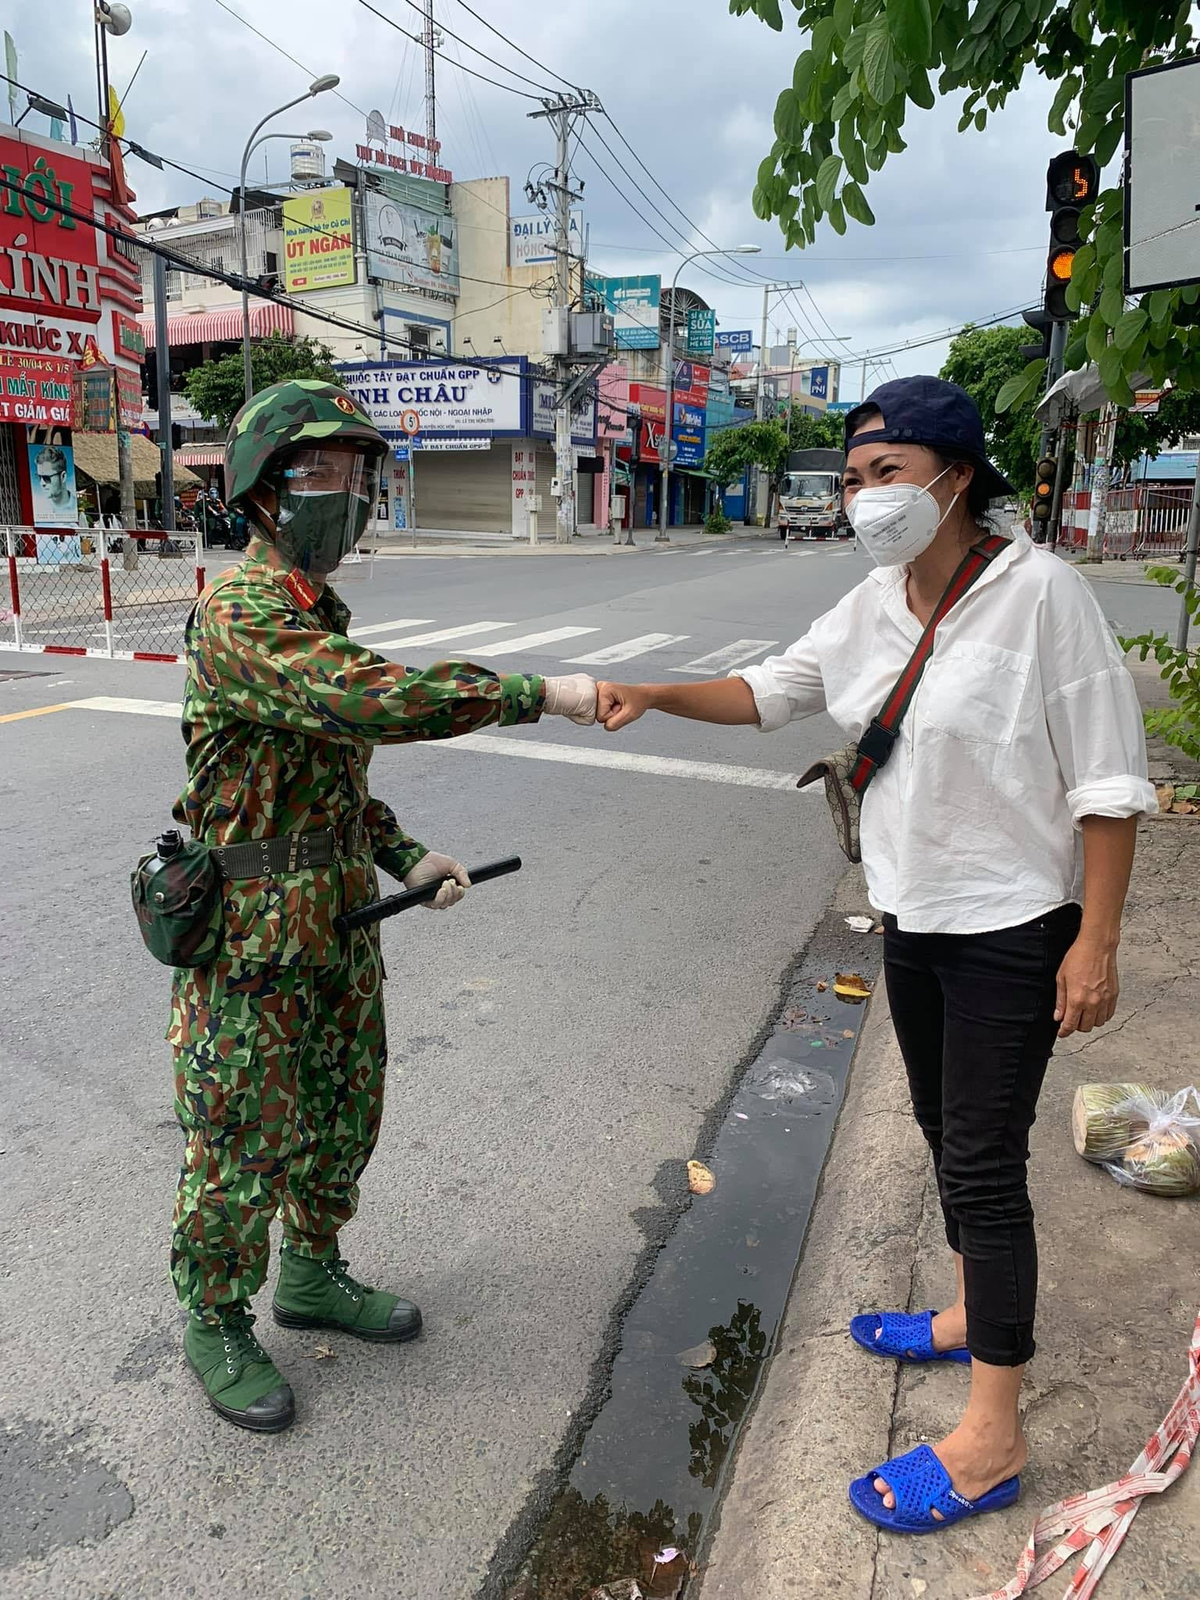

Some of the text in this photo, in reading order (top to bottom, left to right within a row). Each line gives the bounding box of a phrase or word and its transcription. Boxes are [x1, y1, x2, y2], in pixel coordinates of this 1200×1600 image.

[1075, 168, 1088, 197] 5
[0, 156, 76, 229] IỚI
[514, 222, 533, 240] ĐẠI
[287, 238, 306, 259] ÚT
[309, 231, 351, 255] NGÂN
[690, 317, 712, 330] SỮA
[0, 320, 62, 352] KHÚC
[720, 333, 749, 344] SCB
[18, 357, 43, 370] 30/04
[45, 362, 53, 372] &
[57, 363, 70, 374] 1/5
[373, 370, 393, 382] TÂY
[396, 372, 416, 384] ĐẠT
[419, 368, 455, 382] CHUẨN
[458, 370, 480, 380] GPP
[349, 383, 467, 405] INH CHÂU
[811, 385, 826, 395] PNJ
[0, 403, 10, 418] T
[15, 400, 47, 420] GIẢM
[373, 409, 389, 417] CÁC
[447, 408, 471, 418] NGOẠI
